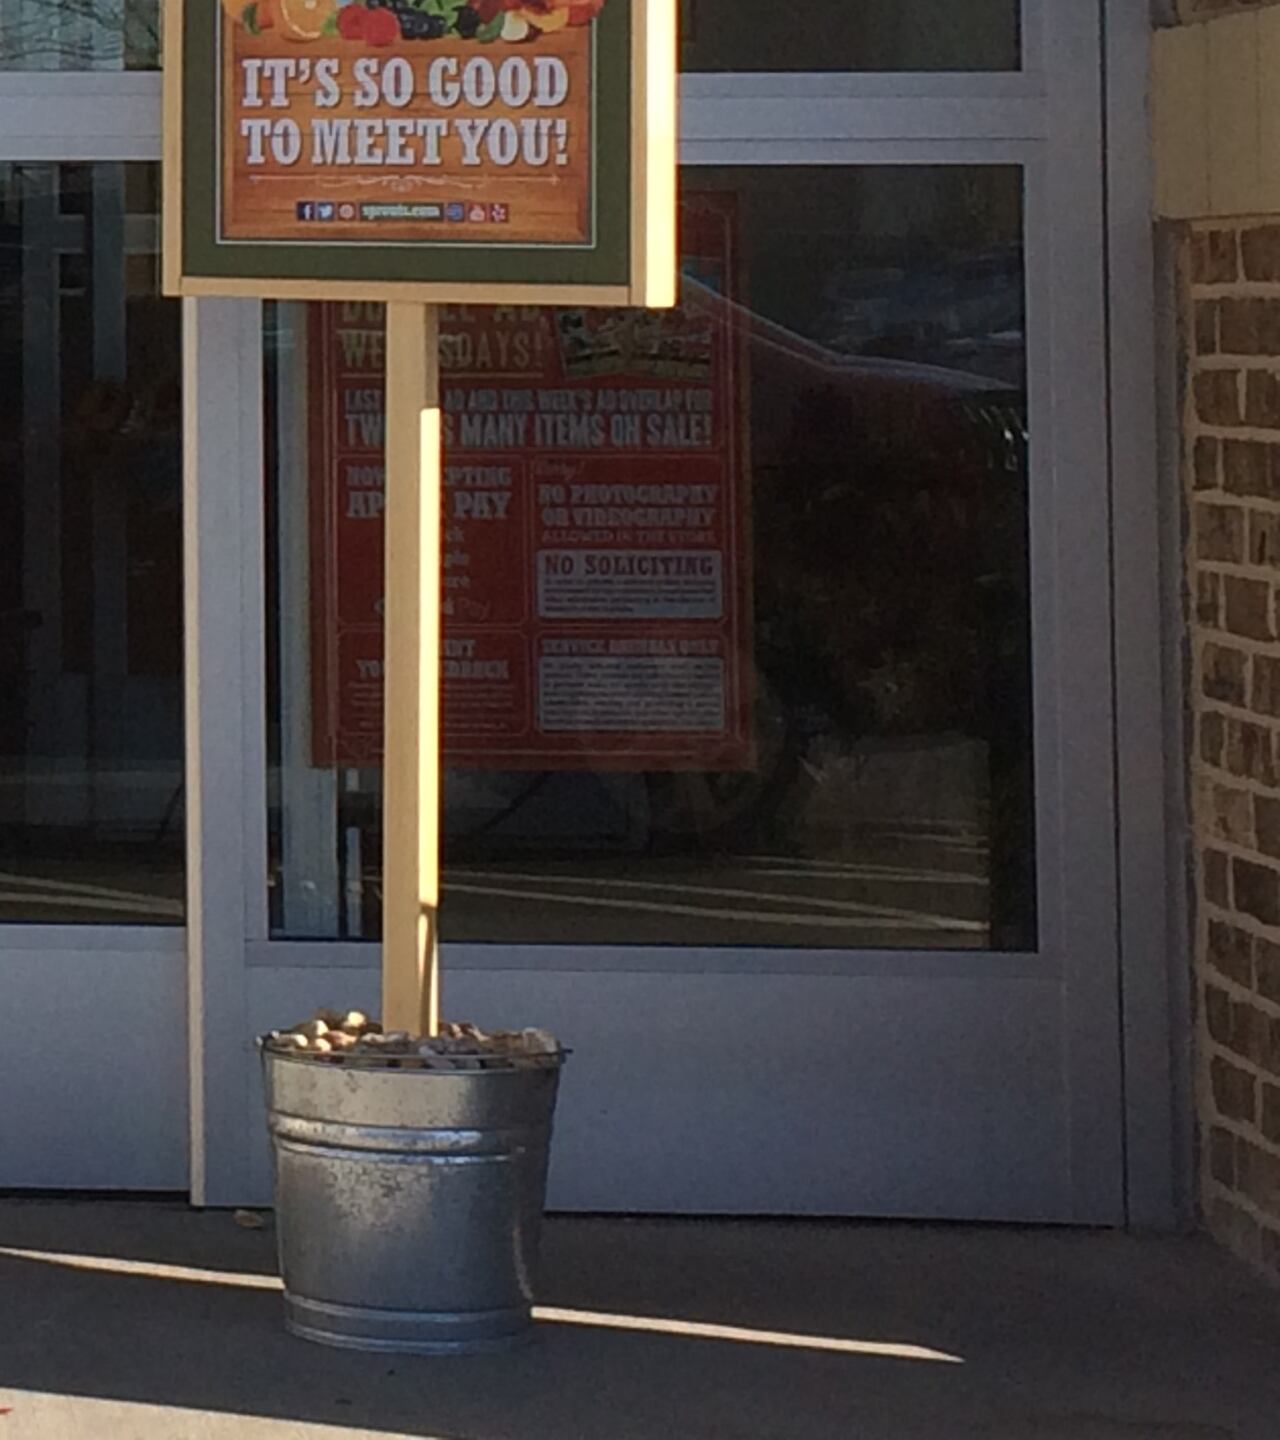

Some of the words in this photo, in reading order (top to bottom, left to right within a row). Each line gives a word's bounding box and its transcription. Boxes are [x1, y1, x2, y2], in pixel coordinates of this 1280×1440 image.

[243, 58, 340, 107] IT'S
[354, 58, 414, 107] SO
[429, 57, 568, 107] GOOD
[242, 118, 301, 165] TO
[312, 118, 447, 165] MEET
[455, 118, 568, 165] YOU!
[460, 413, 527, 447] MANY
[535, 413, 605, 447] ITEMS
[611, 413, 640, 446] ON
[646, 413, 711, 447] SALE!
[545, 555, 575, 576] NO
[584, 555, 714, 576] SOLICITING
